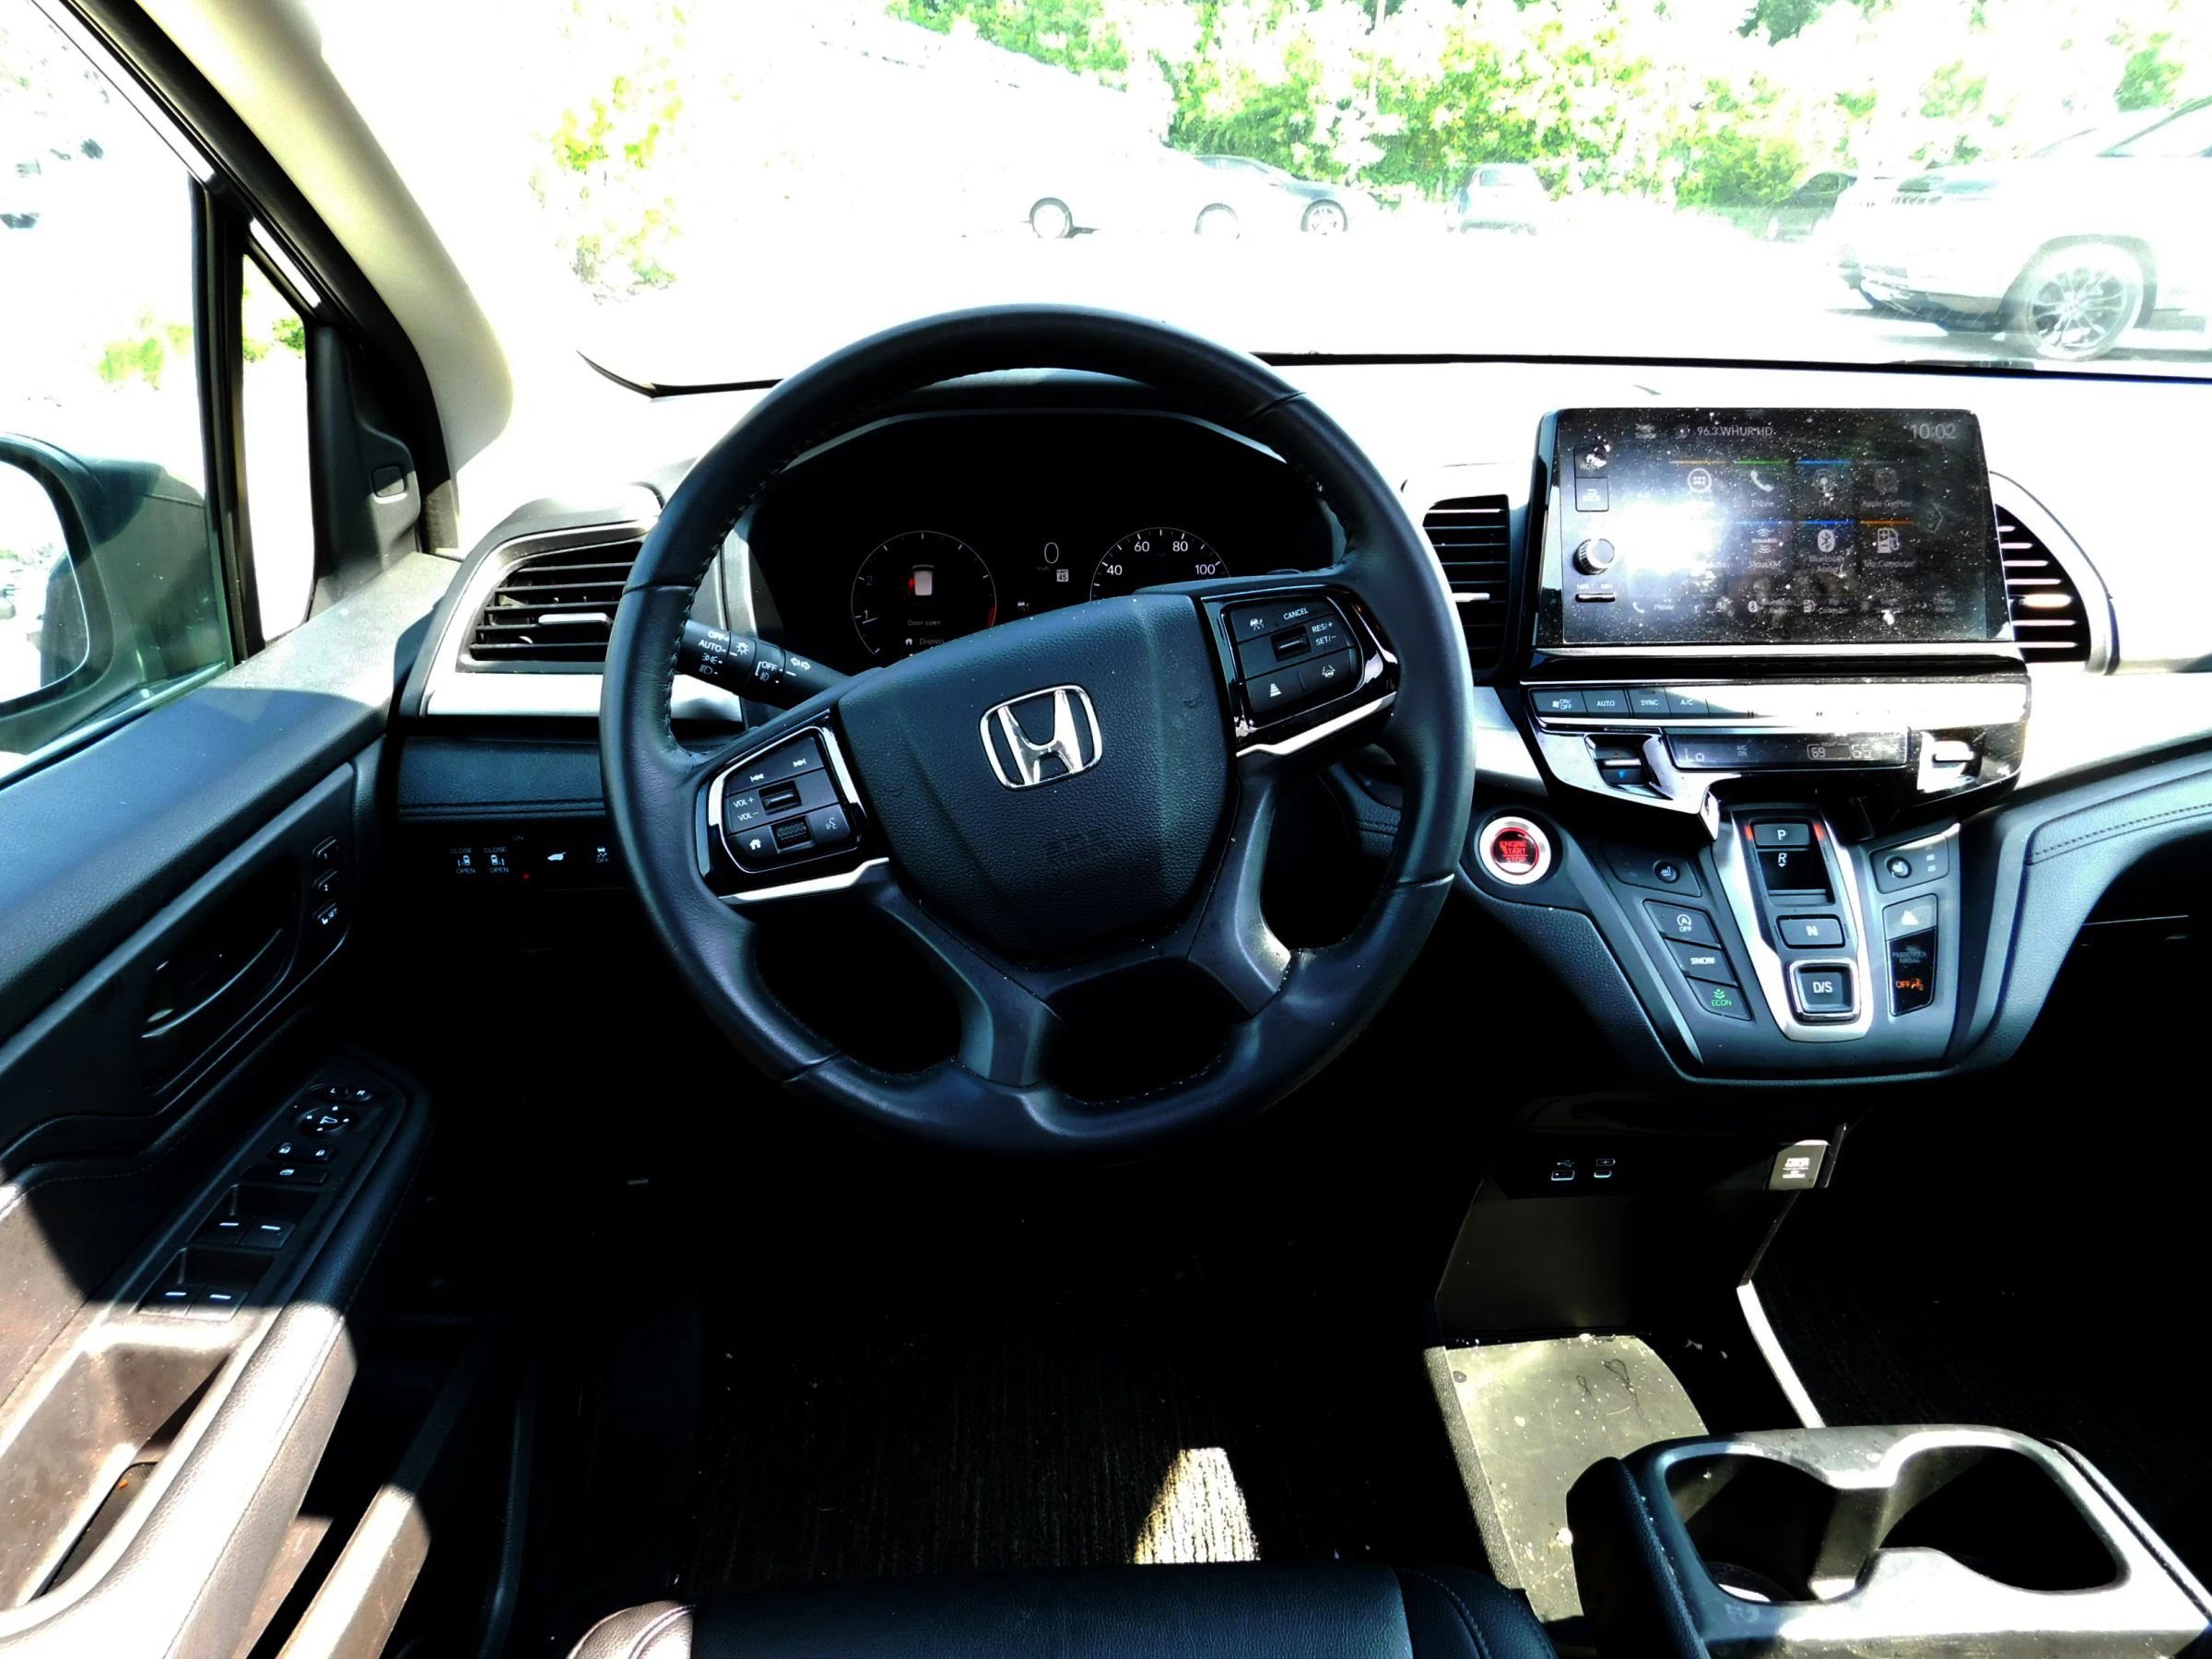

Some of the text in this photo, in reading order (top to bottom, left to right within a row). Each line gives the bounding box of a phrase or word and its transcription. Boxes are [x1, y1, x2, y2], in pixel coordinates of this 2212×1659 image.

[1911, 423, 1958, 441] 10:02
[1134, 540, 1150, 553] 60
[1171, 540, 1188, 553] 80
[1106, 564, 1123, 576] 40
[1194, 563, 1217, 575] 100
[865, 575, 874, 586] 2
[1283, 607, 1309, 619] CANCEL
[907, 618, 942, 629] Door open
[699, 640, 723, 653] AUTO
[761, 661, 778, 671] OFF
[1811, 747, 1827, 759] 69
[1777, 830, 1786, 841] P
[1778, 853, 1787, 863] R
[1806, 925, 1818, 936] N
[1812, 981, 1833, 994] D/S
[1711, 998, 1732, 1006] ECON
